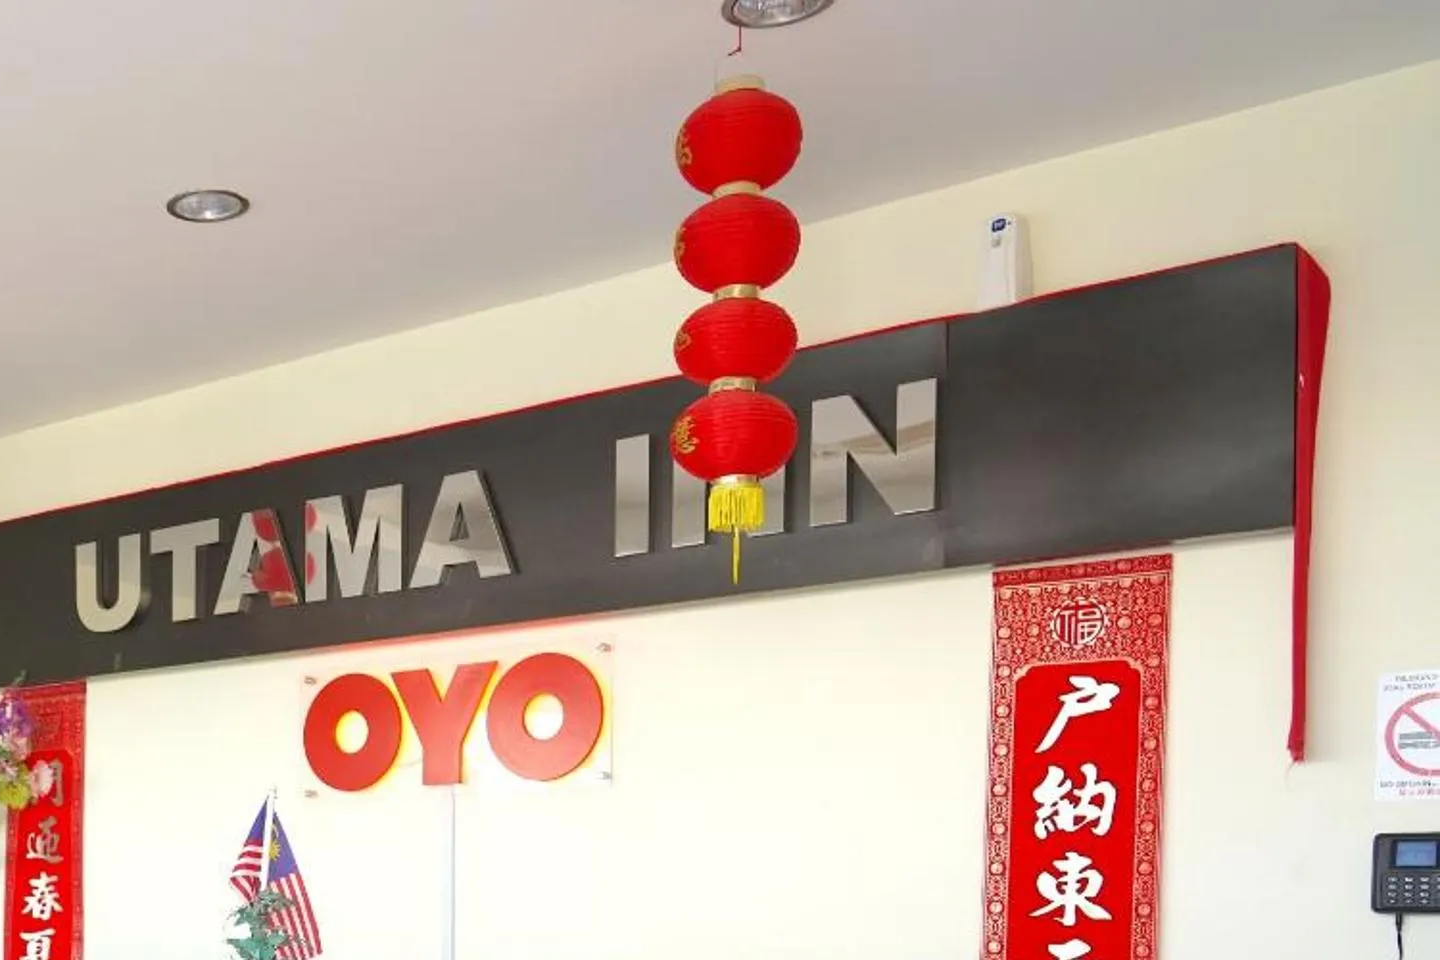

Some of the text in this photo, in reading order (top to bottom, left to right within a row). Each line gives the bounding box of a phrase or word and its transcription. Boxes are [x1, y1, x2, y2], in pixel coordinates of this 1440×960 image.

[74, 469, 516, 633] UTAMA
[1053, 599, 1104, 647] 福
[302, 651, 605, 792] OYO
